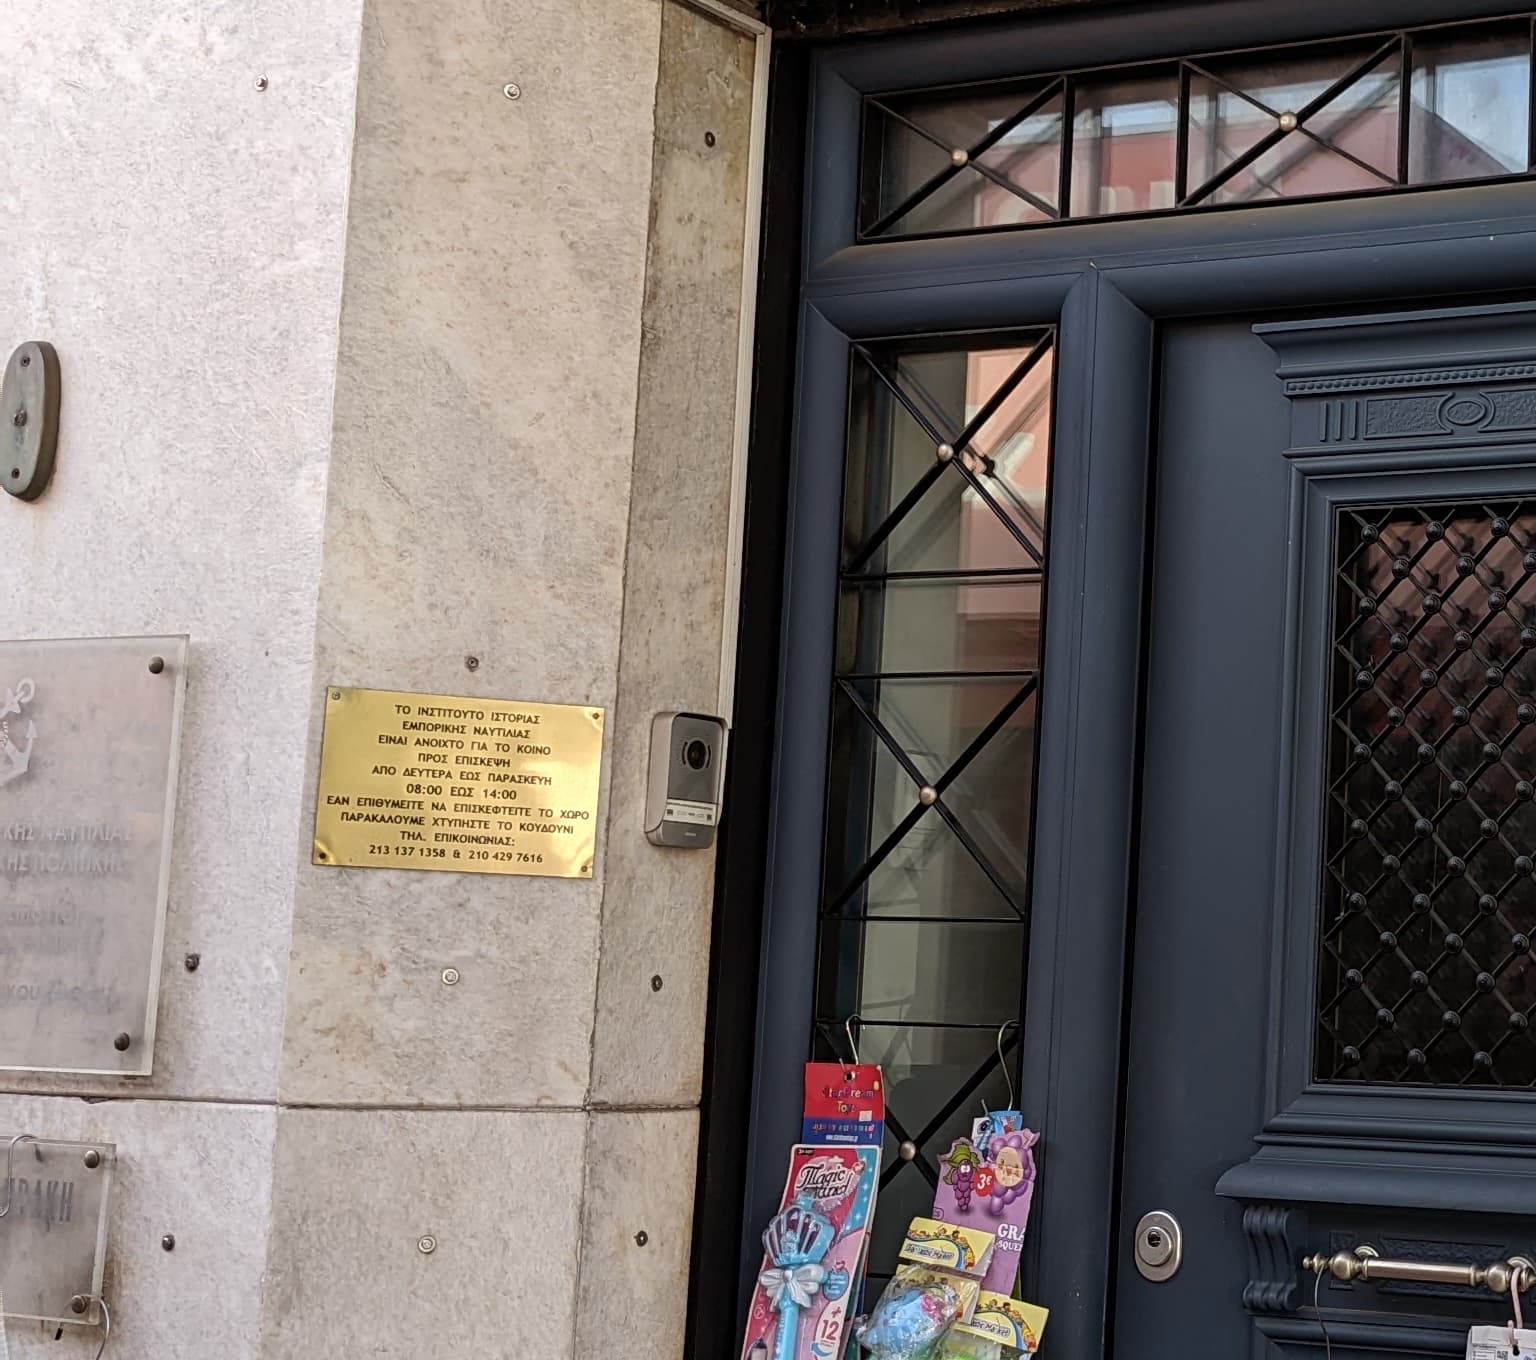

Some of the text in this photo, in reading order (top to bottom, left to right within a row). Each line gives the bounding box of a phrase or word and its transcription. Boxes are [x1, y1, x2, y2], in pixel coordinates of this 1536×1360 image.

[395, 704, 541, 725] ΤΟ ΙΝΣΤΙΤΟΥΤΟ ΙΣΤΟΡΙΑΣ
[402, 720, 531, 739] ΕΜΠΟΡΙΚΗΣ ΝΑΥΤΙΛΙΑΣ
[378, 734, 551, 755] ΕΙΝΑΙ ΑΝΟΙΧΤΟ ΓΙΑ ΤΟ ΚΟΙΝΟ
[418, 753, 511, 768] ΠΡΟΣ ΕΠΙΣΚΕΨΗ
[371, 765, 552, 786] ΑΠΟ ΔΕΥΤΕΡΑ ΕΩΣ ΠΑΡΑΣΚΕΥΗ
[406, 783, 517, 800] 08:00 ΕΩΣ 14:00
[326, 795, 590, 820] ΕΑΝ ΕΠΙΘΥΜΕΙΤΕ ΝΑ ΕΠΙΣΚΕΦΤΕΙΤΕ ΤΟ ΧΩΡΟ
[340, 812, 574, 835] ΠΑΡΑΚΑΛΟΥΜΕ ΧΤΥΠΗΣΤΕ ΤΟ ΚΟΥΔΟΥΝΙ
[399, 830, 516, 847] ΤΗΛ. ΕΠΙΚΟΙΝΩΝΙΑΣ:
[369, 844, 390, 855] 213
[394, 846, 415, 857] 137
[419, 847, 446, 859] 1358
[468, 849, 489, 861] 210
[492, 851, 513, 862] 429
[516, 852, 543, 864] 7616
[796, 1163, 846, 1192] Magic
[977, 1172, 993, 1190] 3€
[821, 1319, 840, 1341] 12
